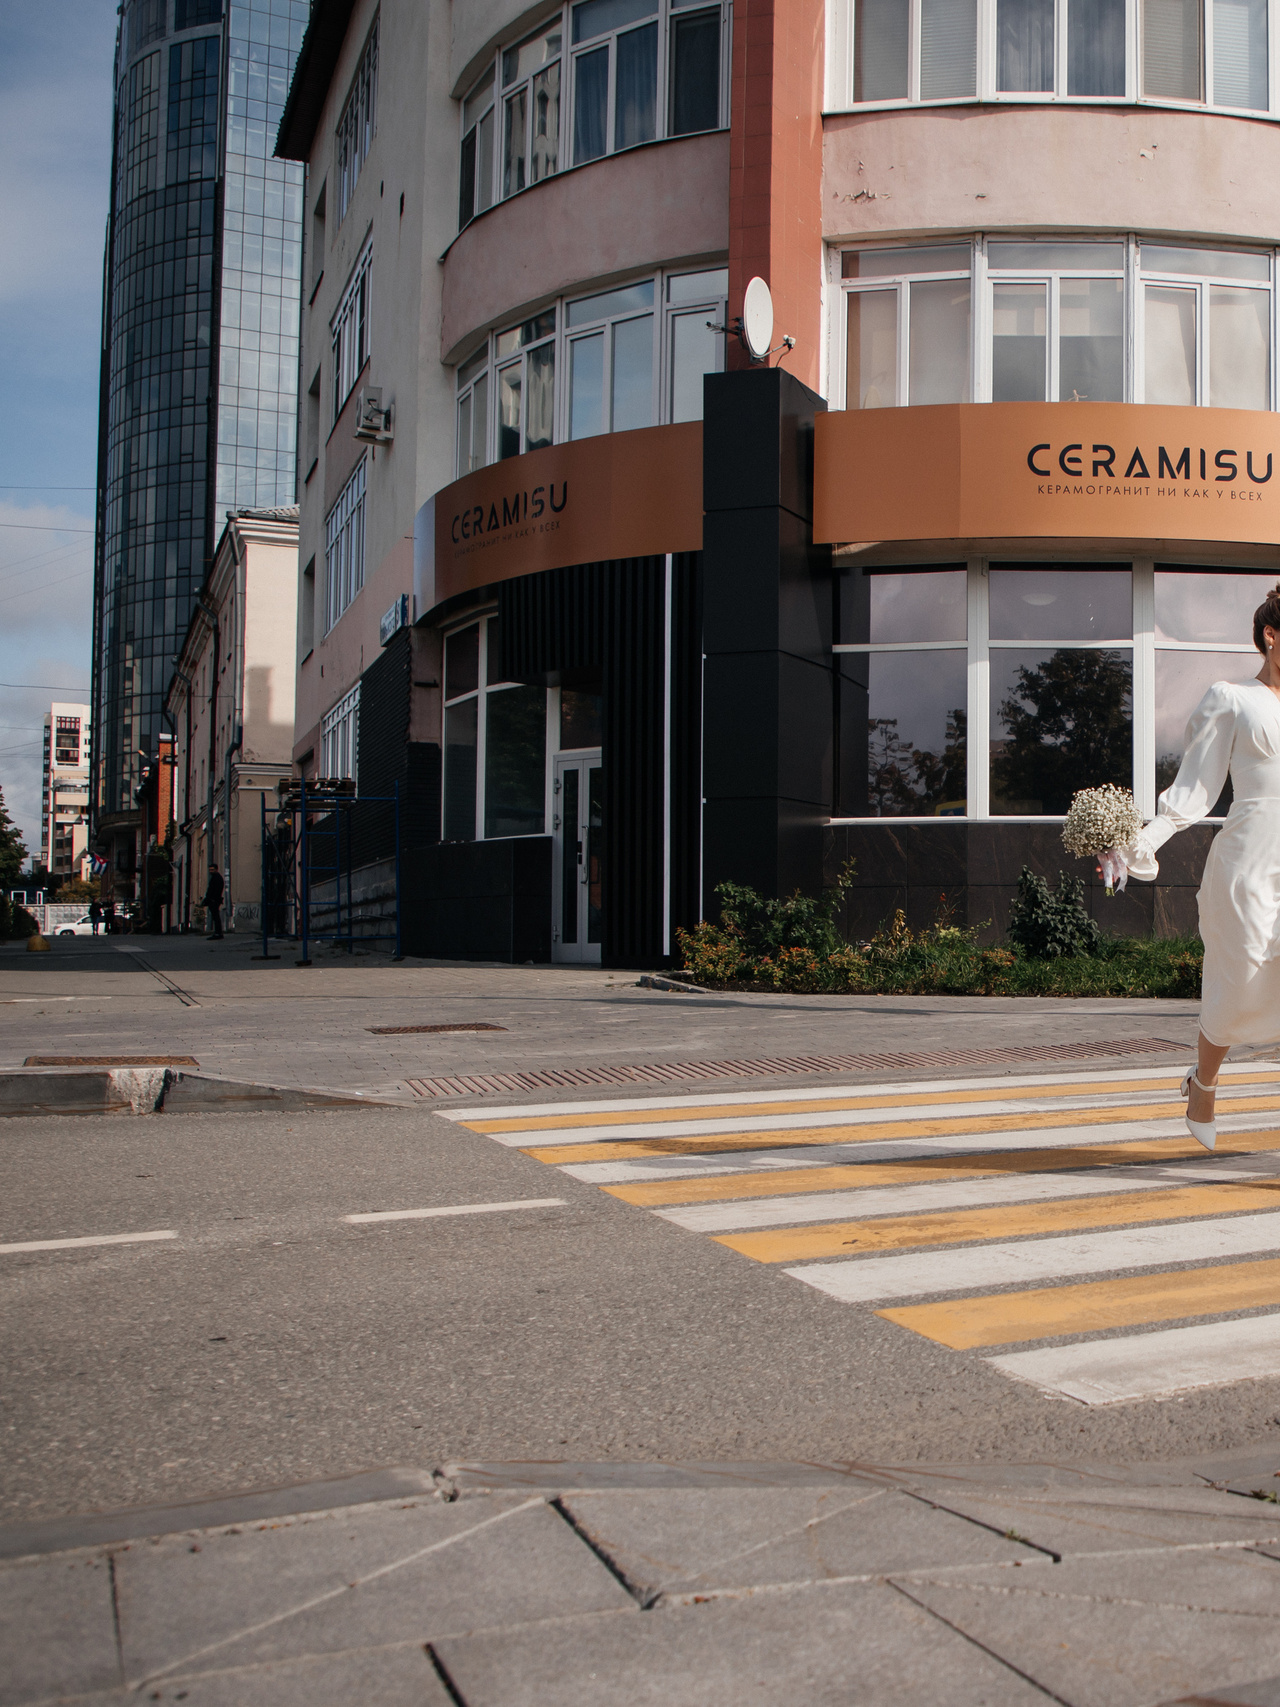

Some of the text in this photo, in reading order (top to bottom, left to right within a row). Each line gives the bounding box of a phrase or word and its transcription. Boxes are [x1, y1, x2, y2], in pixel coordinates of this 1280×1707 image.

[1027, 443, 1272, 484] CERAMISU
[1038, 484, 1263, 502] КЕРАМОГРАНИТ НИ КАК У ВСЕХ
[451, 480, 568, 544] CERAMISU
[539, 520, 561, 533] ВСЕХ
